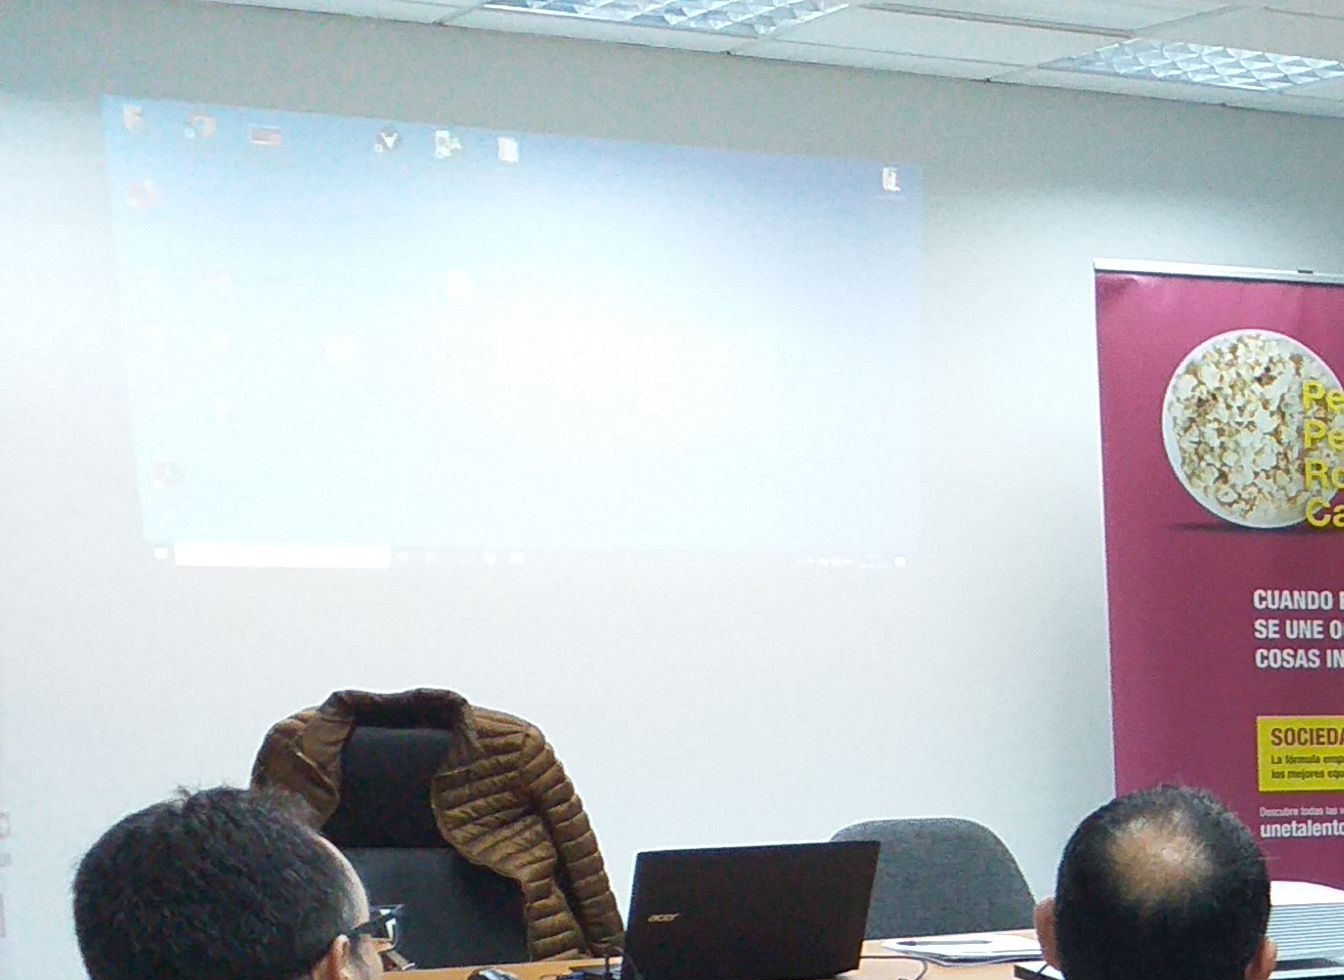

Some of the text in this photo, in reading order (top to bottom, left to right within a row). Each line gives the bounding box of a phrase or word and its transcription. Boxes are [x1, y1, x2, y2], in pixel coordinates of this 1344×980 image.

[1253, 589, 1334, 611] CUANDO
[1254, 618, 1281, 639] SE
[1285, 619, 1325, 639] UNE
[1255, 648, 1321, 669] COSAS
[1271, 755, 1283, 765] La
[1285, 754, 1321, 765] fórmula
[1271, 769, 1286, 779] los
[1288, 769, 1325, 780] mejores
[647, 912, 681, 923] acer
